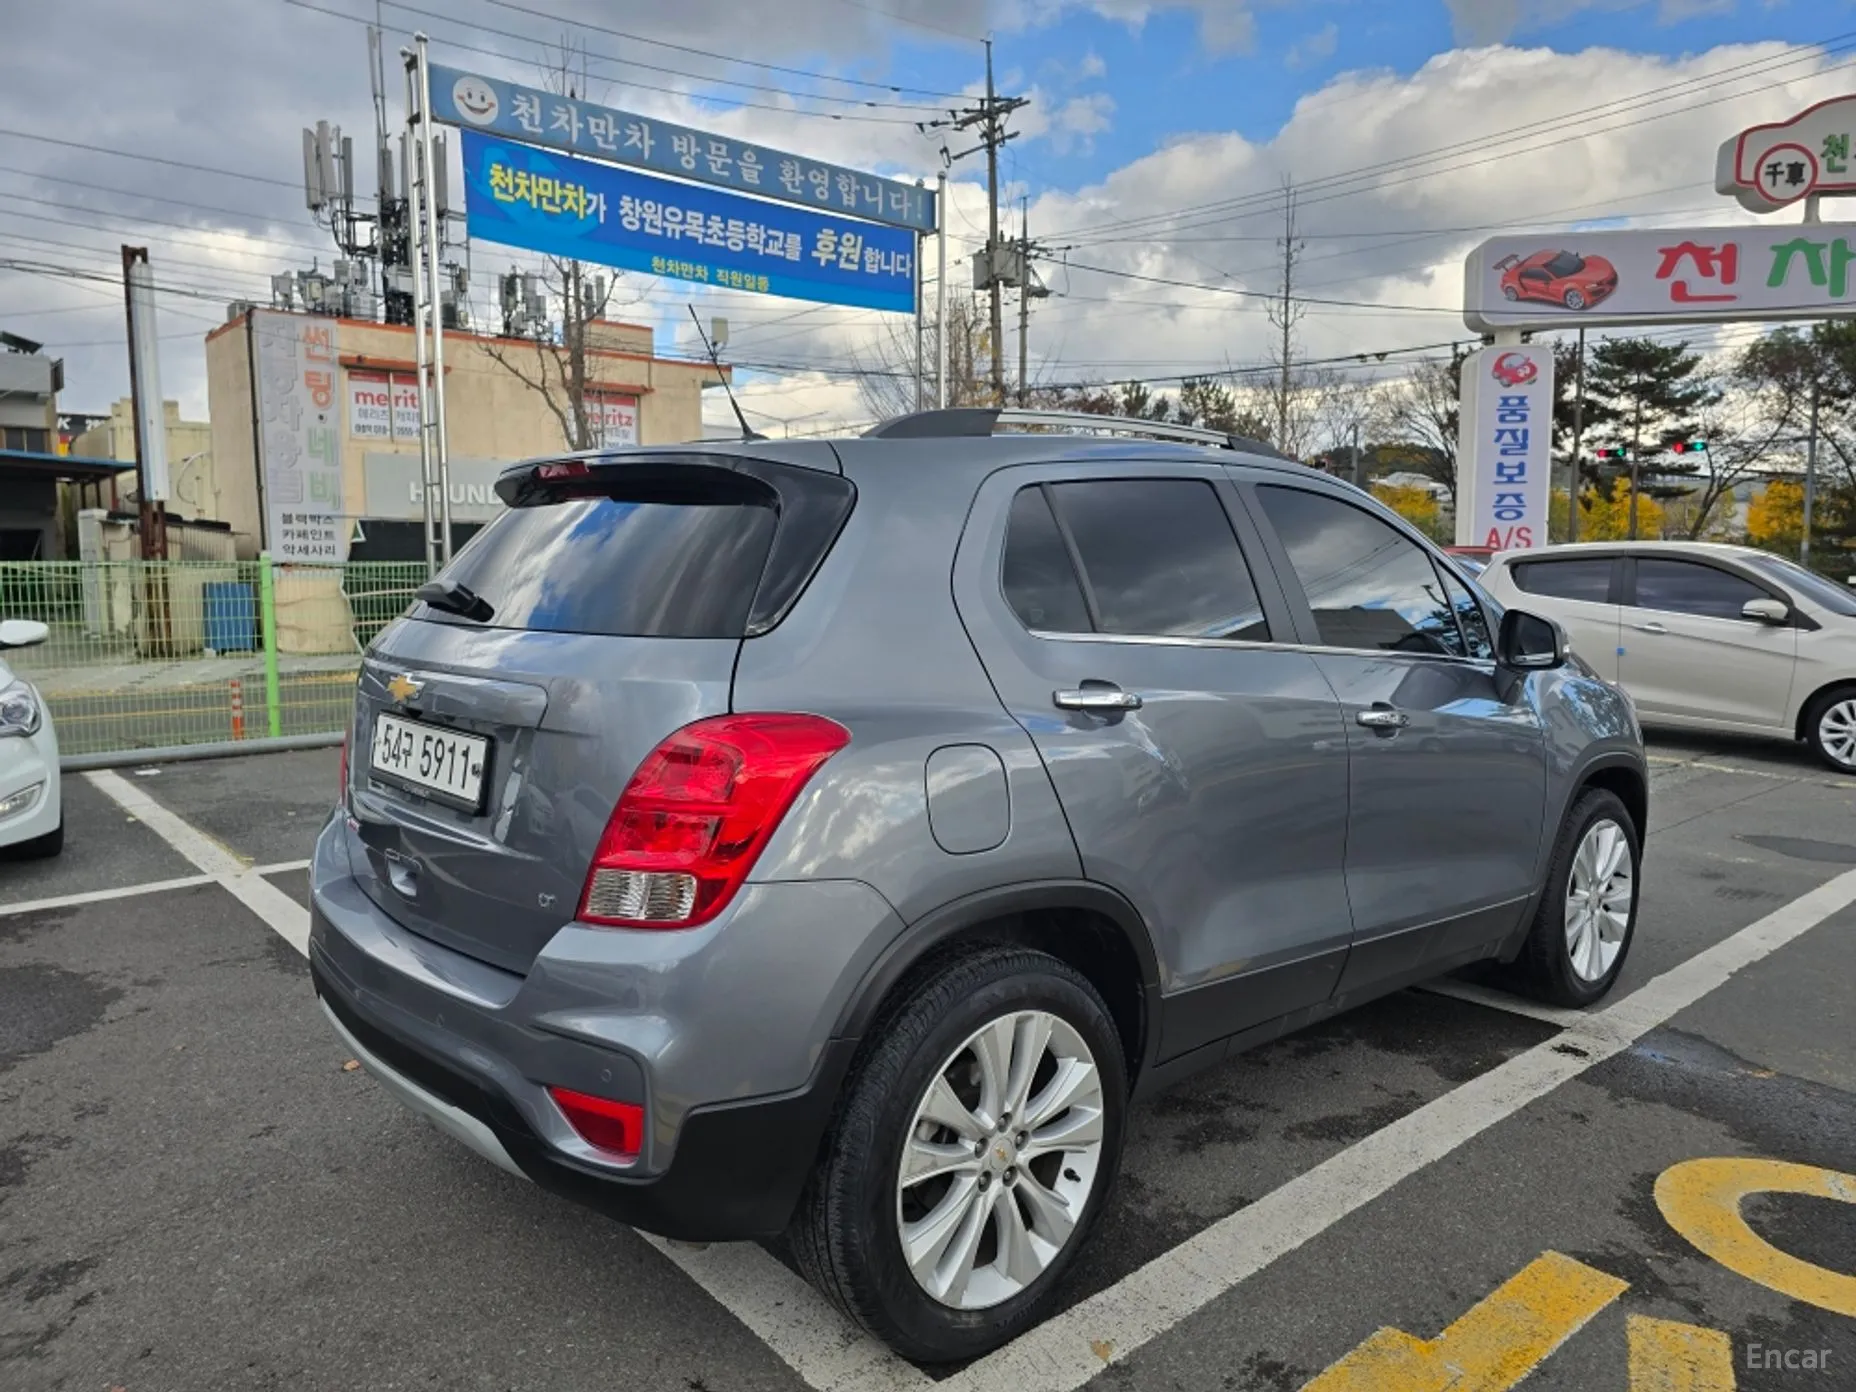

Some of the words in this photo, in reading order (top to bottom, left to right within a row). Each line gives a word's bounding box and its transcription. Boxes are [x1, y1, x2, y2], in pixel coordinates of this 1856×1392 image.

[511, 94, 656, 160] 천차만차
[672, 134, 764, 185] 방문을
[778, 160, 923, 221] 환영합니다!
[1820, 133, 1856, 174] 천
[489, 163, 607, 224] 천차만차가
[619, 195, 803, 262] 창원유목초등학교를
[651, 255, 709, 282] 천차만차
[354, 389, 419, 409] merit
[1492, 395, 1531, 522] 품질보증
[281, 513, 335, 525] 블랙박스
[282, 544, 336, 556] 악세사리
[1486, 526, 1532, 549] A/S
[382, 723, 413, 770] 54구
[420, 734, 471, 791] 5911
